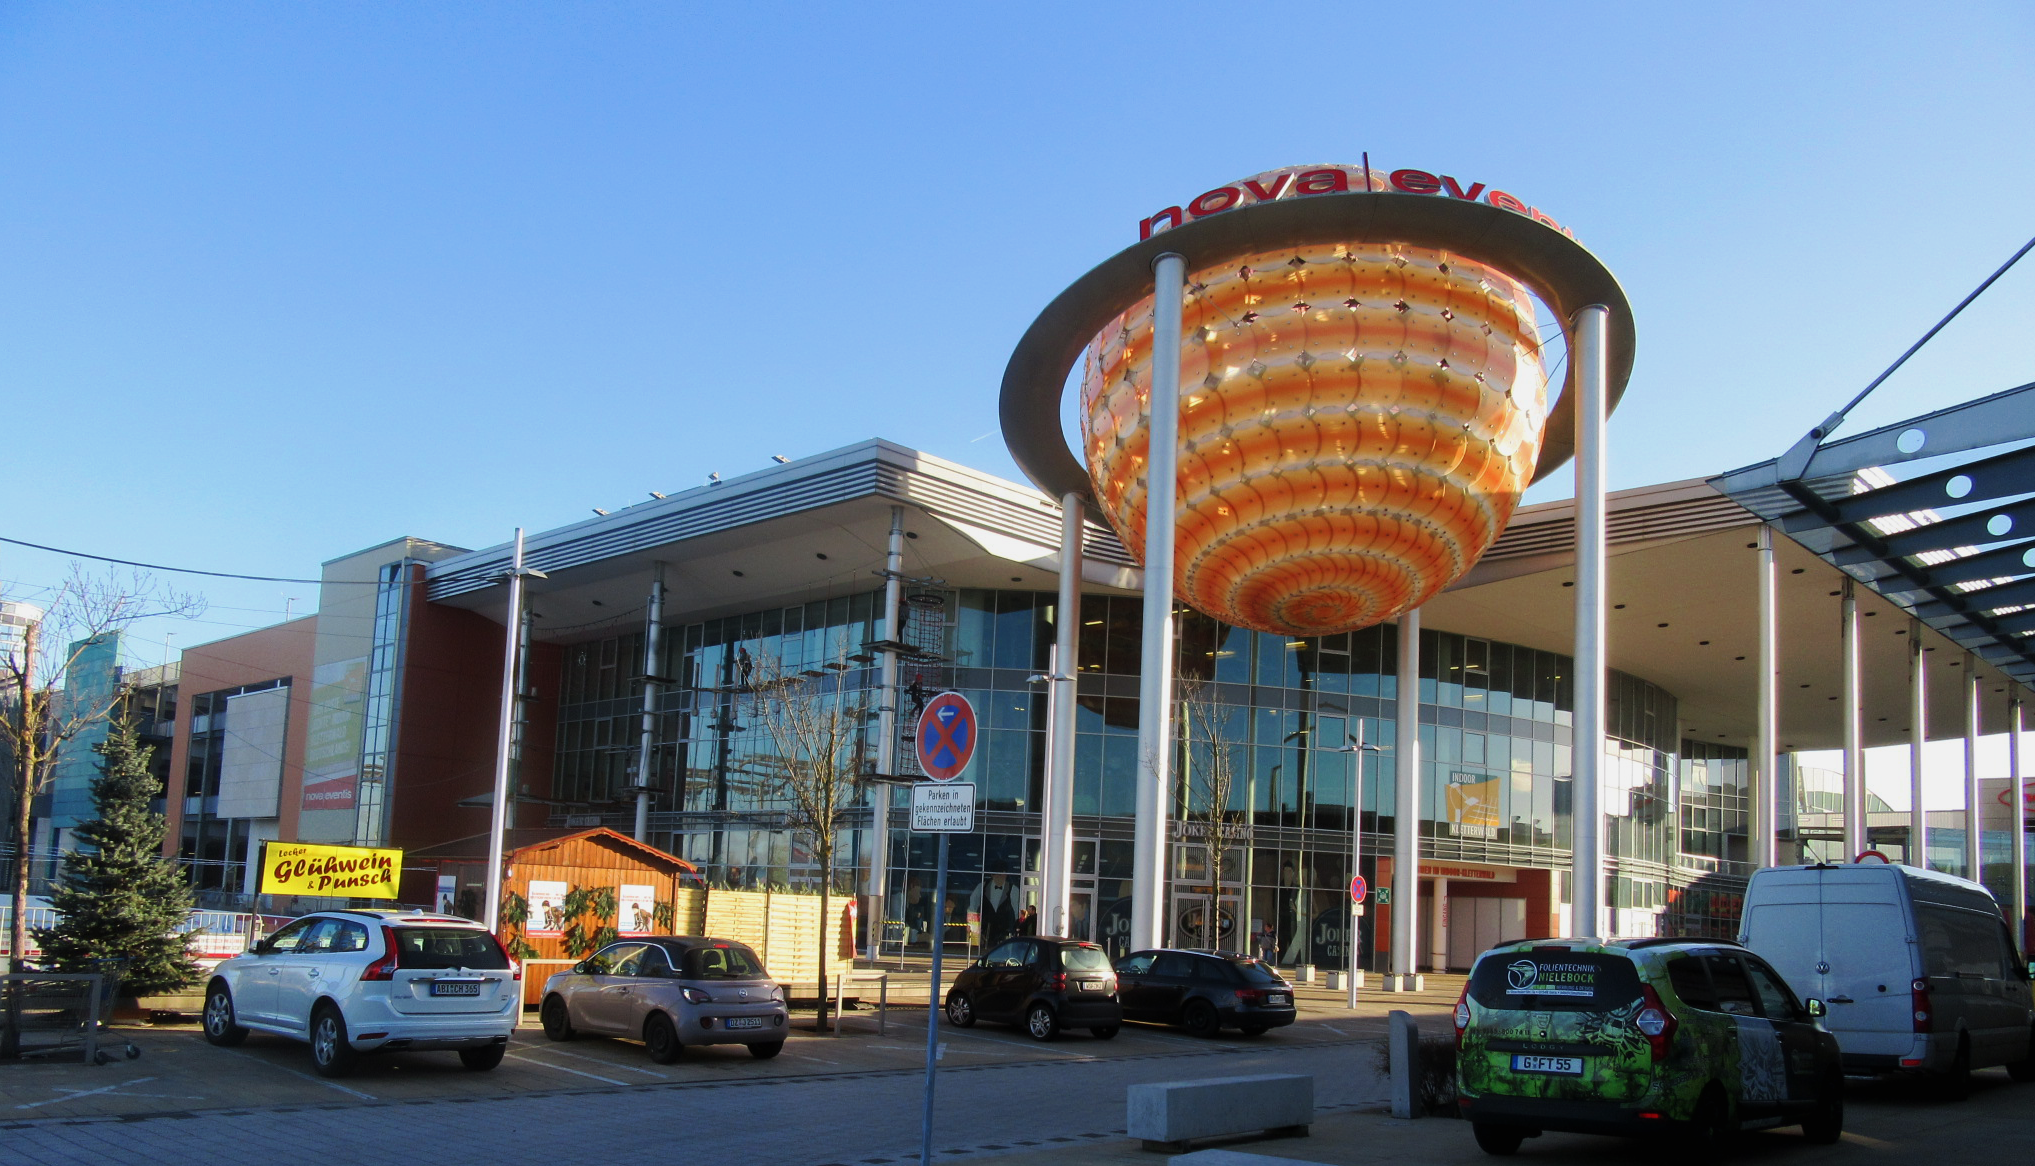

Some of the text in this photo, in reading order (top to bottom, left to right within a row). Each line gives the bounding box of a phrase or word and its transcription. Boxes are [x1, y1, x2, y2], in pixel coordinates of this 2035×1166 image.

[1139, 168, 1583, 246] nova event
[1452, 772, 1476, 784] INDOOR
[305, 789, 353, 801] nova eventis
[928, 789, 959, 800] Parken in
[915, 803, 971, 816] gekennzeichneten
[917, 815, 967, 826] Flächen erlaubt
[1173, 820, 1213, 838] JOKE
[274, 852, 392, 884] Glühwein
[306, 868, 392, 891] & Punsch
[1315, 923, 1363, 945] JOE
[1539, 963, 1595, 973] FOLIENTECHNIK
[1538, 972, 1595, 984] NIELEBOCK
[1524, 1057, 1572, 1071] G FT 55
